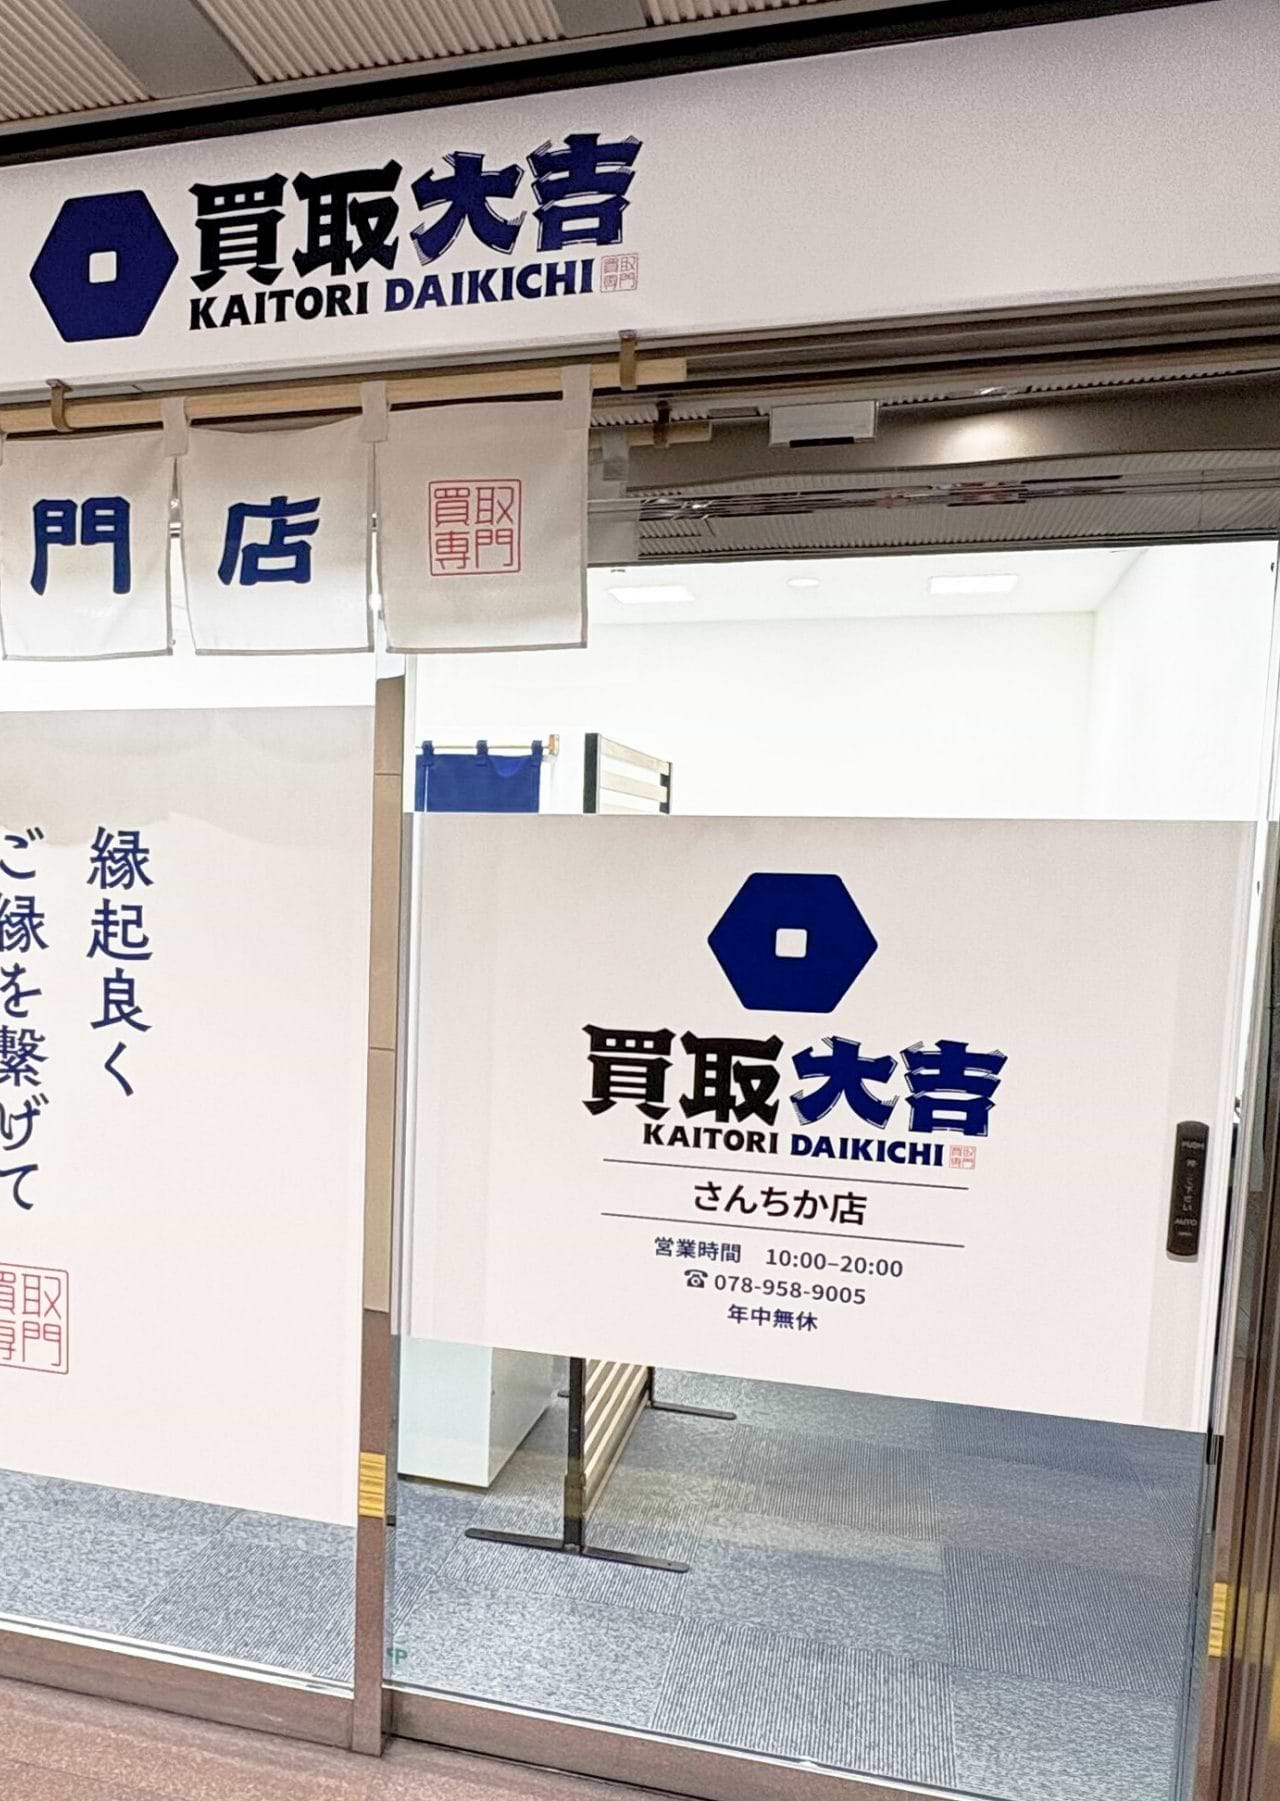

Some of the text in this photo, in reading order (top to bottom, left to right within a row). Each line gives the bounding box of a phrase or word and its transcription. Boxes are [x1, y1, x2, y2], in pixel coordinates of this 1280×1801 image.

[188, 133, 643, 291] 買取大吉
[189, 258, 594, 331] KAITORI DAIKICHI
[433, 487, 516, 528] 買取
[433, 529, 516, 570] 専門
[86, 826, 154, 1097] 縁起良く
[581, 1023, 1009, 1137] 買取大吉
[643, 1123, 945, 1168] KAITORI DAIKICHI
[693, 1180, 868, 1226] さんちか店
[654, 1236, 742, 1264] 営業時間
[714, 1273, 867, 1306] 078-958-9005
[727, 1303, 818, 1332] 年中無休
